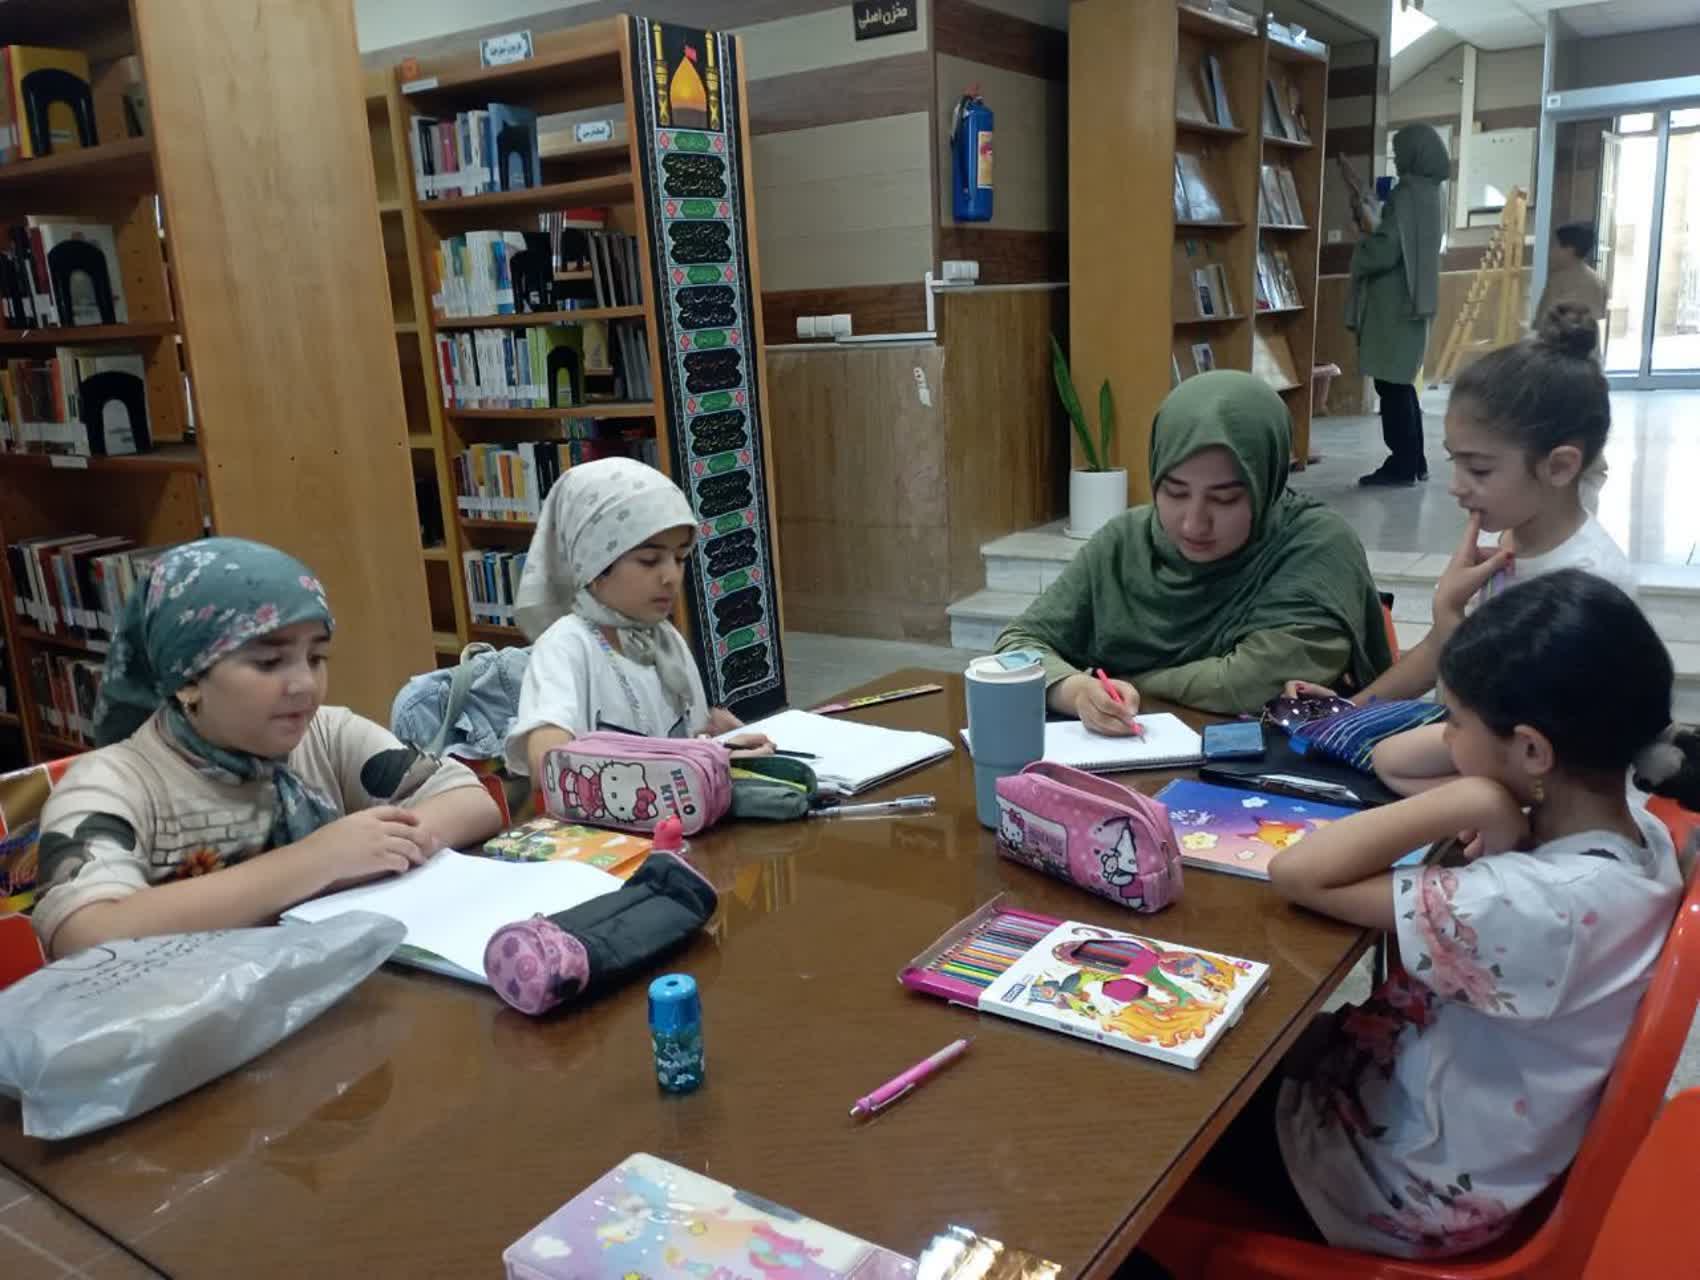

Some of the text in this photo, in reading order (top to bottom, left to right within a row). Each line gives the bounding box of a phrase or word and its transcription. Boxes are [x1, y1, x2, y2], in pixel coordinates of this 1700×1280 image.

[858, 2, 908, 29] مخزن اصلی
[671, 768, 696, 815] HELLO
